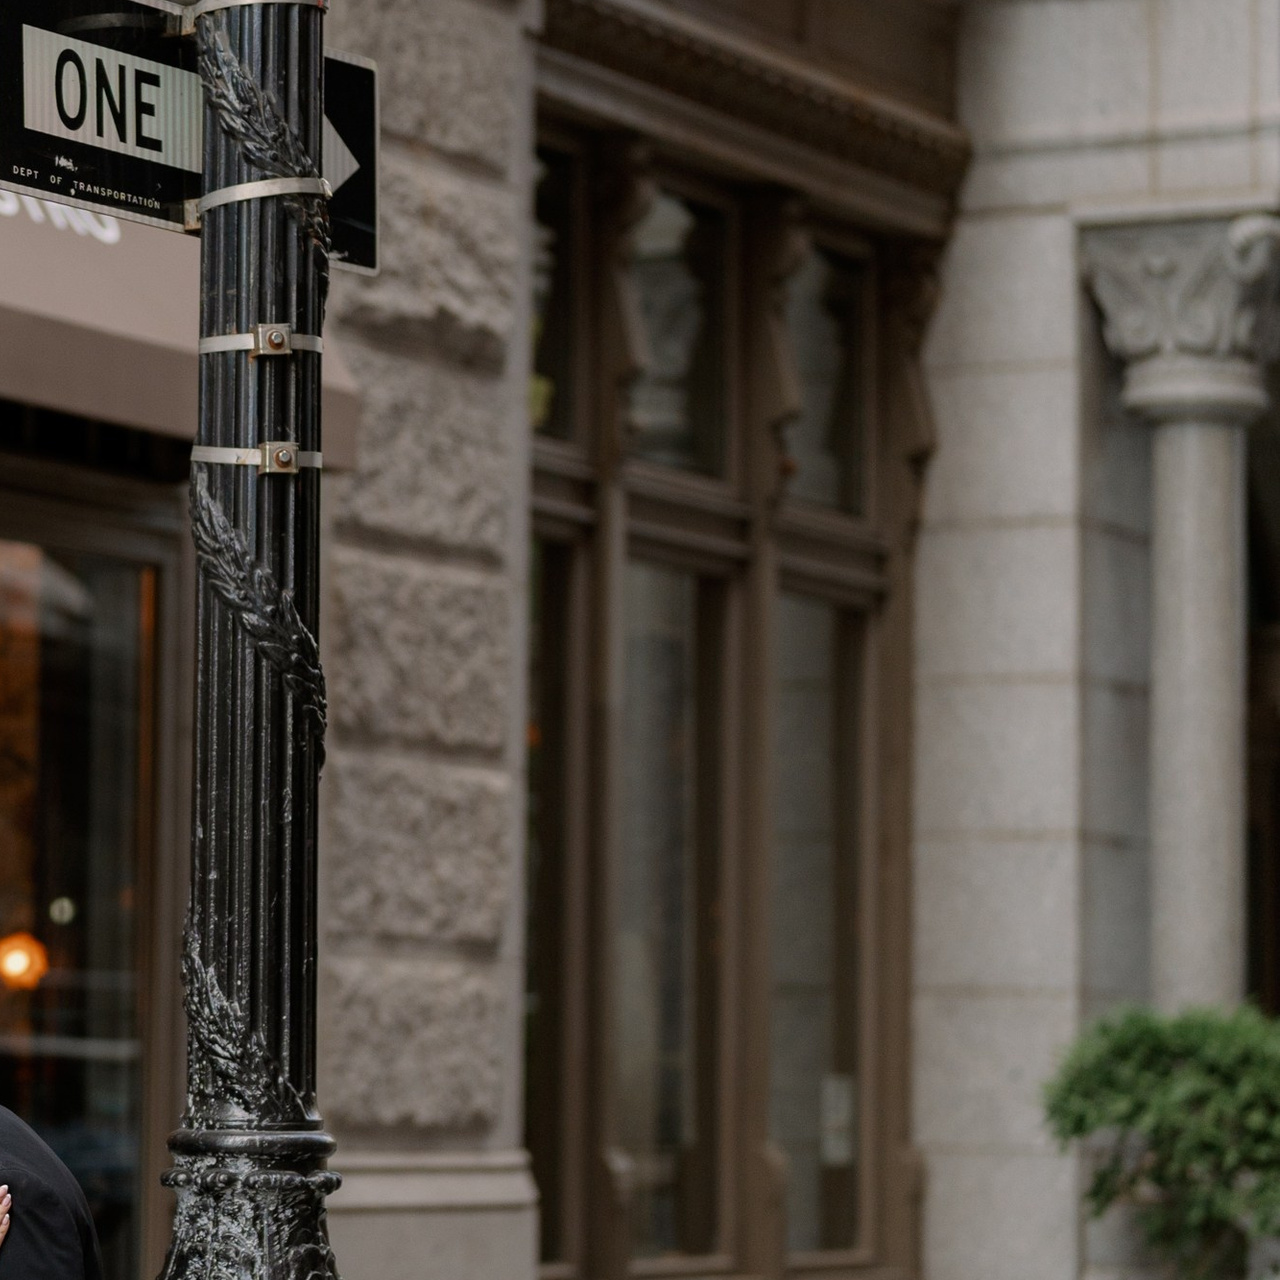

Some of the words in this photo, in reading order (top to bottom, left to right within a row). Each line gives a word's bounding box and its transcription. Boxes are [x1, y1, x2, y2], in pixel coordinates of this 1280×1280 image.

[54, 48, 163, 153] ONE
[12, 165, 39, 180] DEPT
[50, 174, 63, 185] OF
[73, 180, 161, 210] TRANSPORTATION
